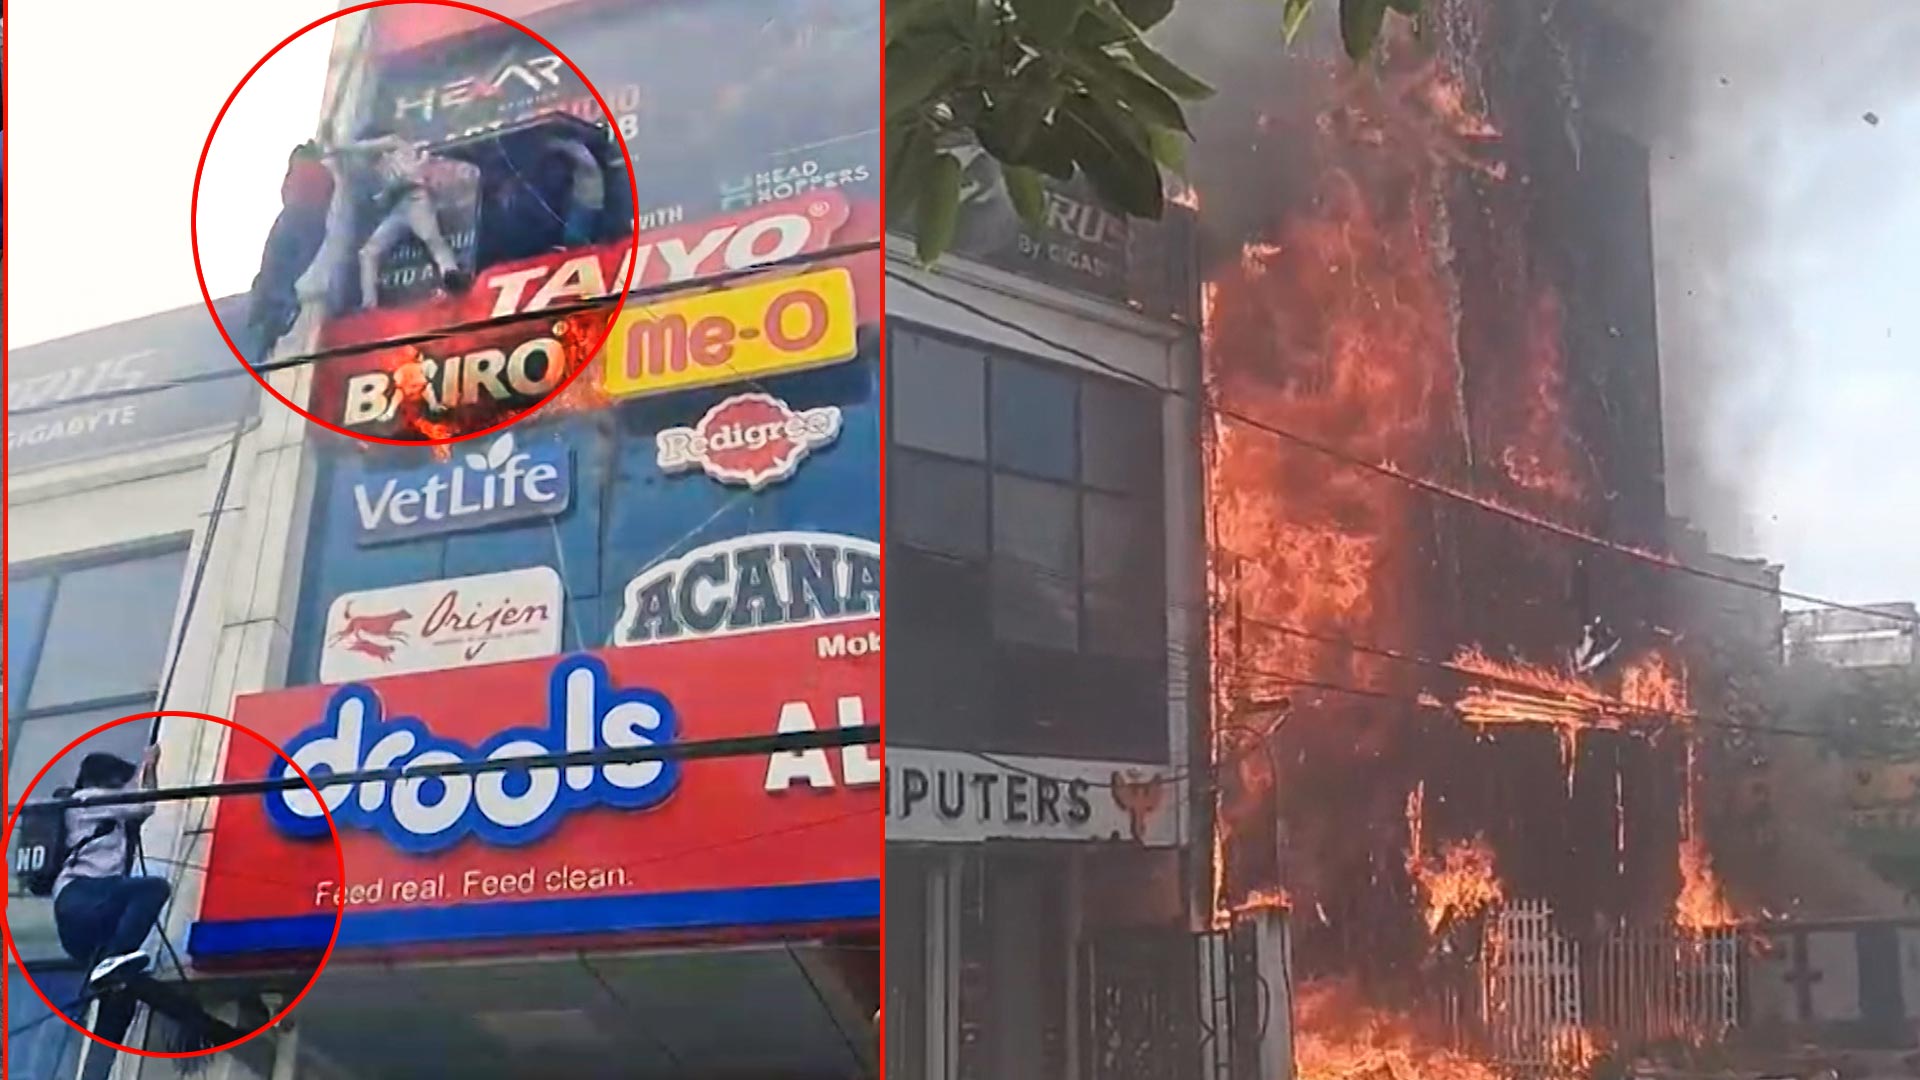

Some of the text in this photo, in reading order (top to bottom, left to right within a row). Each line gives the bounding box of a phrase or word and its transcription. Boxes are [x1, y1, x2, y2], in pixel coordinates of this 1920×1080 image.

[630, 204, 684, 231] WITH
[487, 214, 811, 319] TAIYO
[662, 411, 832, 463] Pedigree
[354, 453, 558, 530] VetLife
[420, 590, 550, 661] Orijen
[281, 667, 663, 834] drools
[764, 696, 880, 790] AL
[885, 767, 1092, 824] PUTERS
[315, 864, 634, 906] Feed real. Feed clean.
